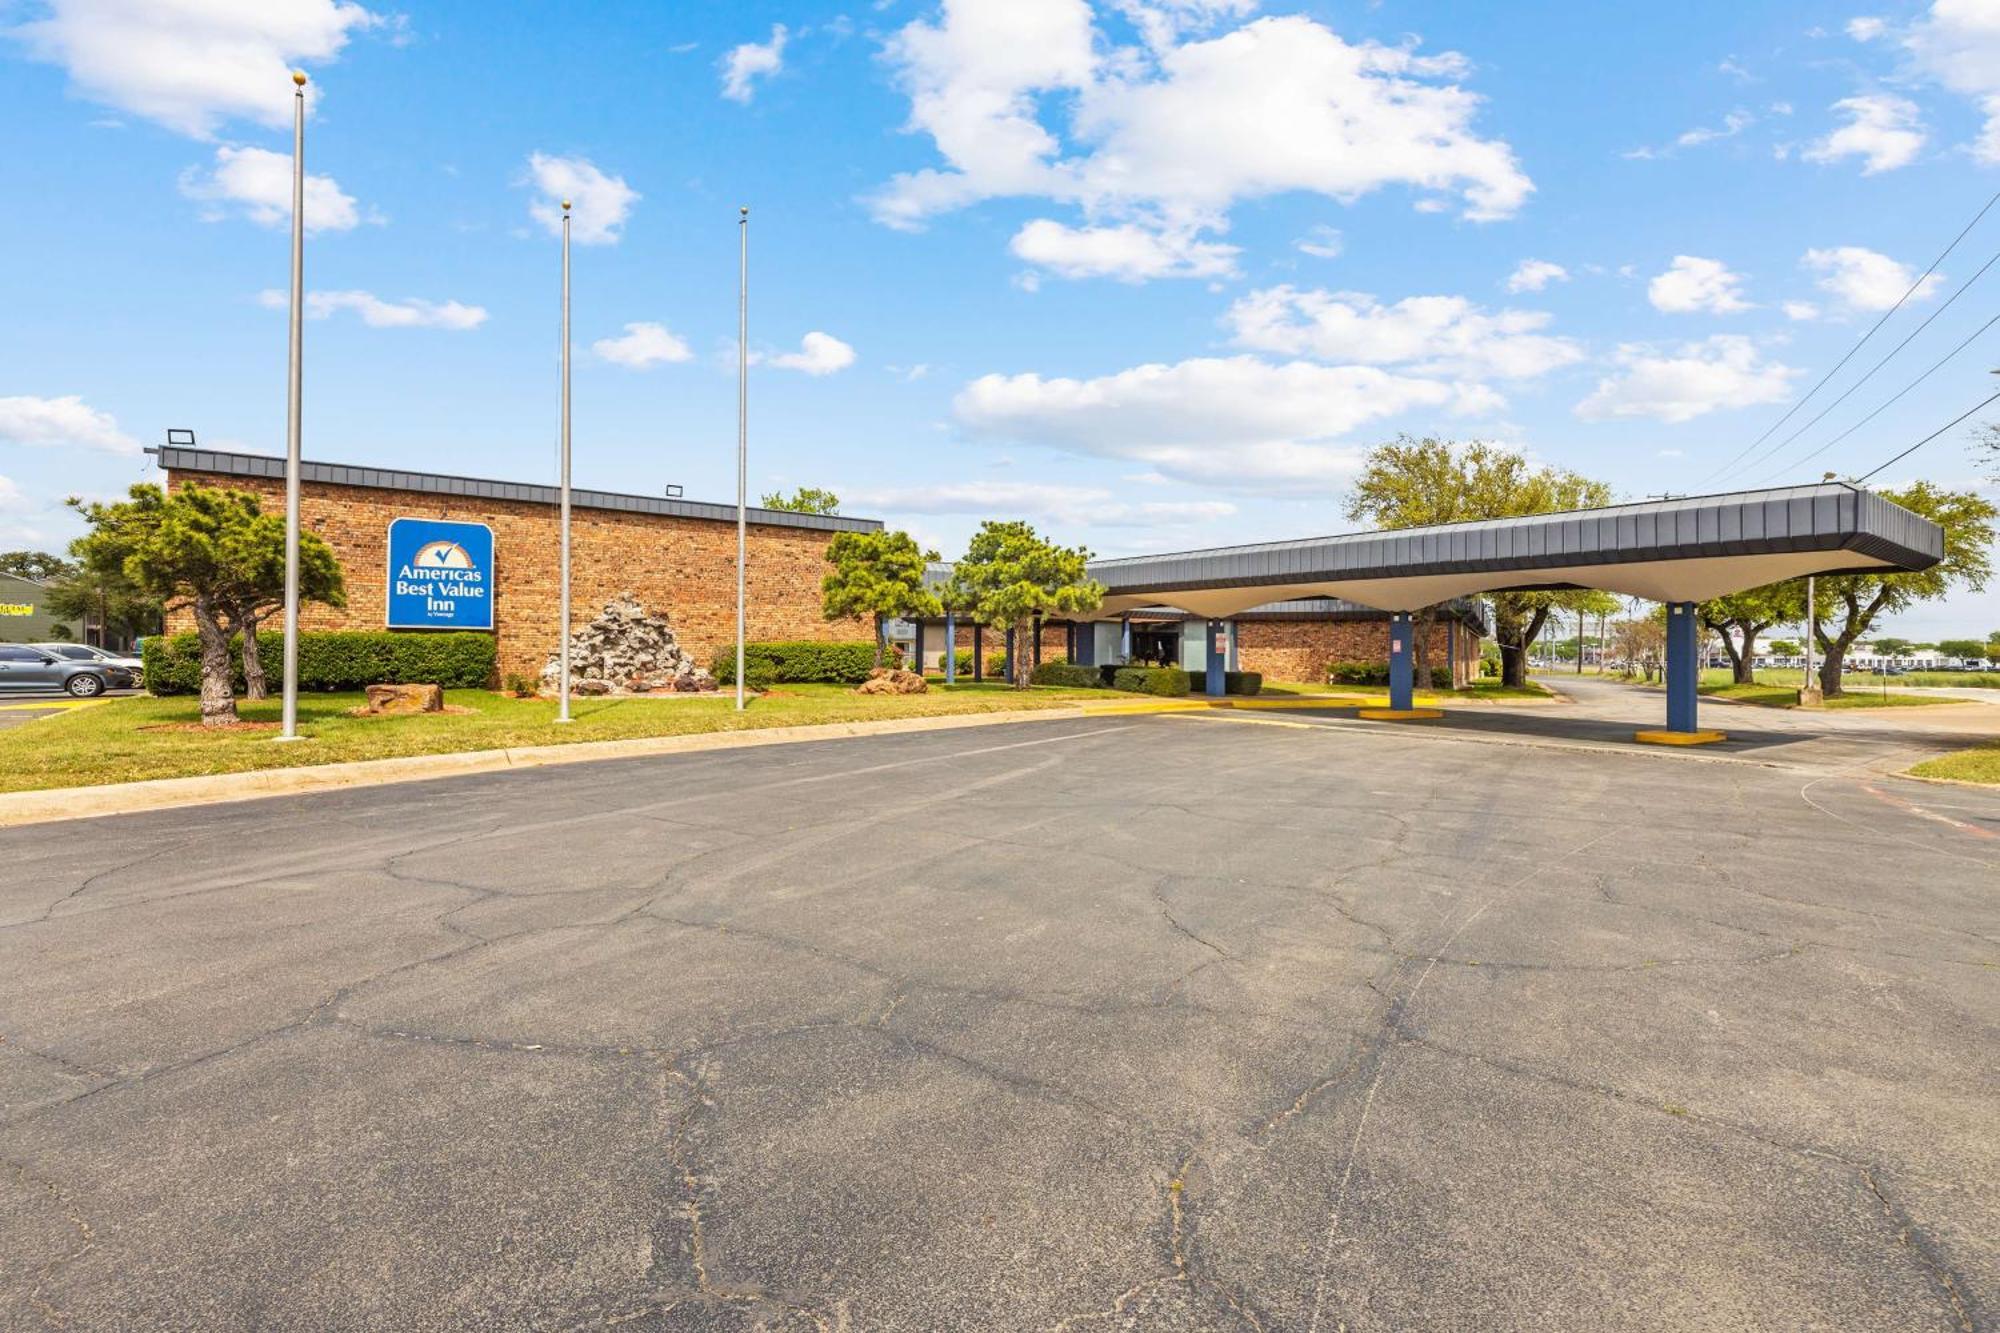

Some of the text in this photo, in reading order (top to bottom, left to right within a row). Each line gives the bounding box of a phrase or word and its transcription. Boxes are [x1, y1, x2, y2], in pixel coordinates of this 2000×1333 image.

[399, 564, 482, 582] Americas
[396, 581, 484, 597] Best Value
[427, 597, 455, 611] Inn
